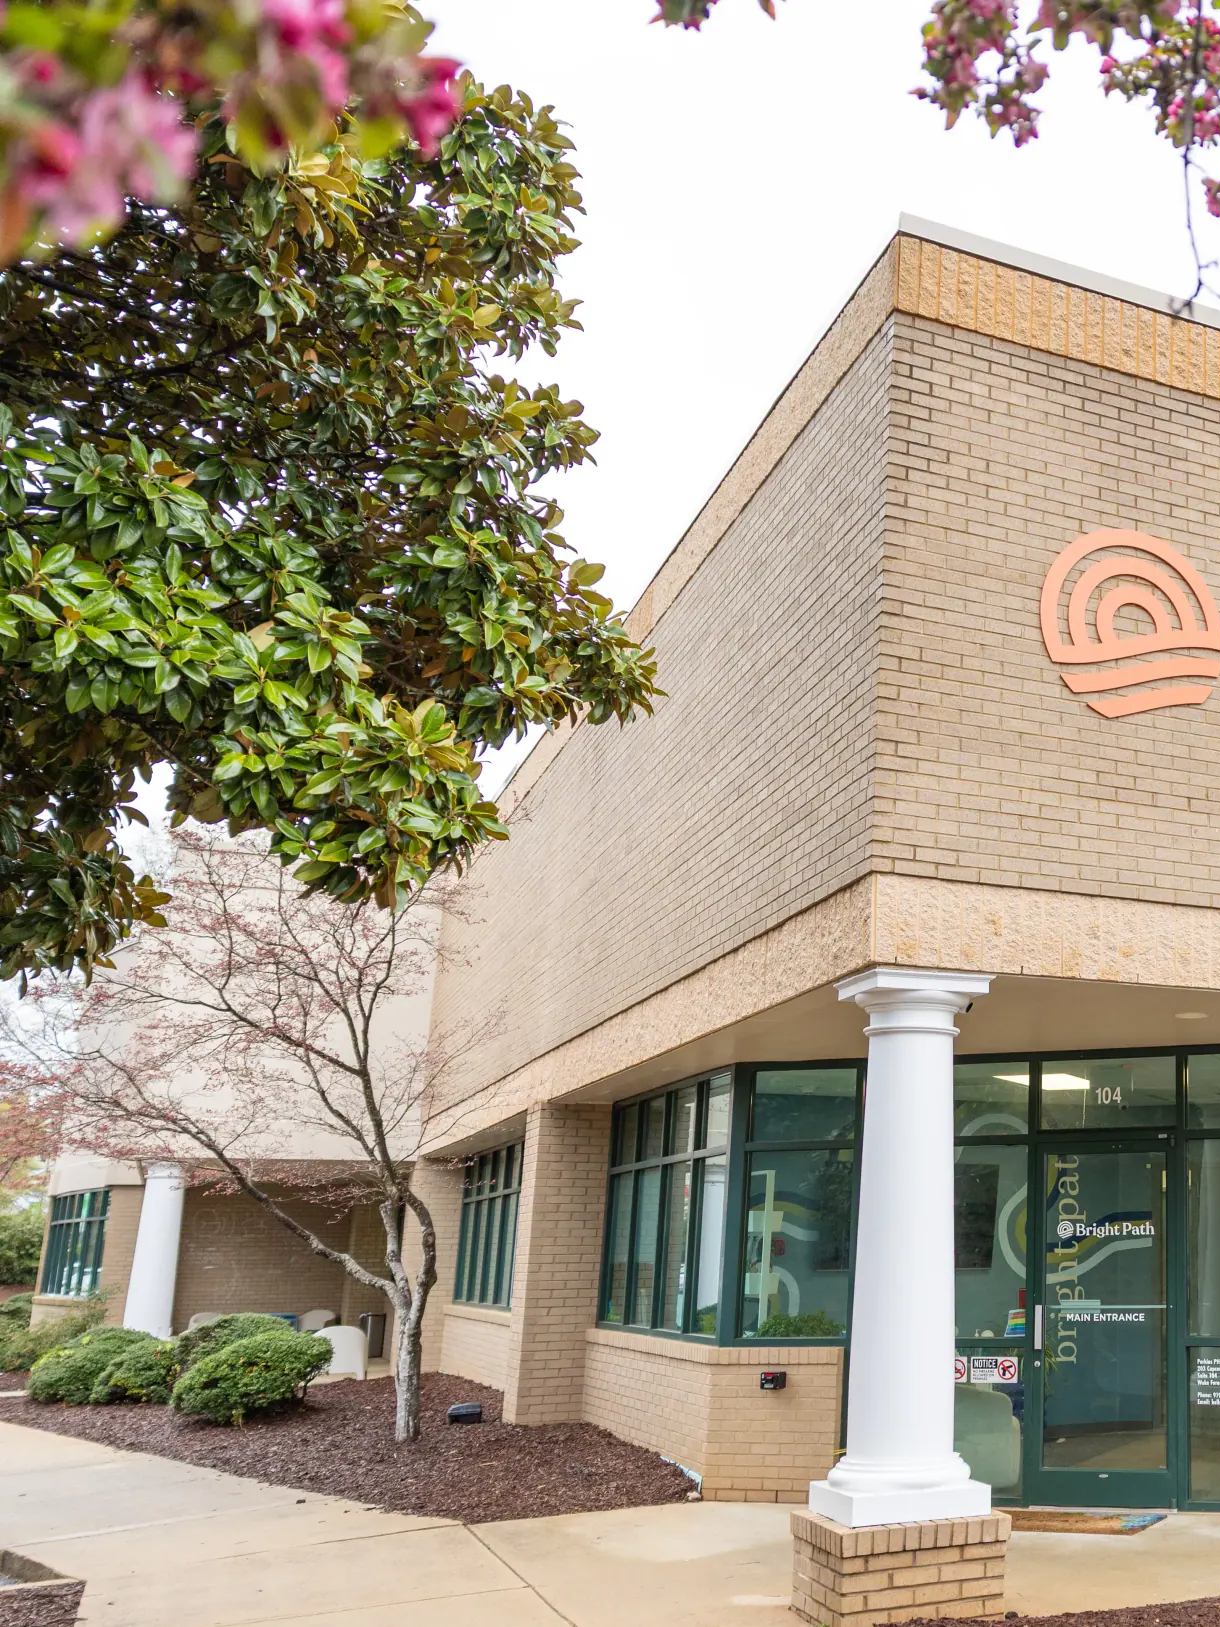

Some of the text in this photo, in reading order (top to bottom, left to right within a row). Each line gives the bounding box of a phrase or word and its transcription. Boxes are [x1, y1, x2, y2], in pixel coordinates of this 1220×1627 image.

[1096, 1086, 1122, 1104] 104
[1075, 1222, 1155, 1239] Bright Path
[1066, 1313, 1145, 1321] MAIN ENTRANCE
